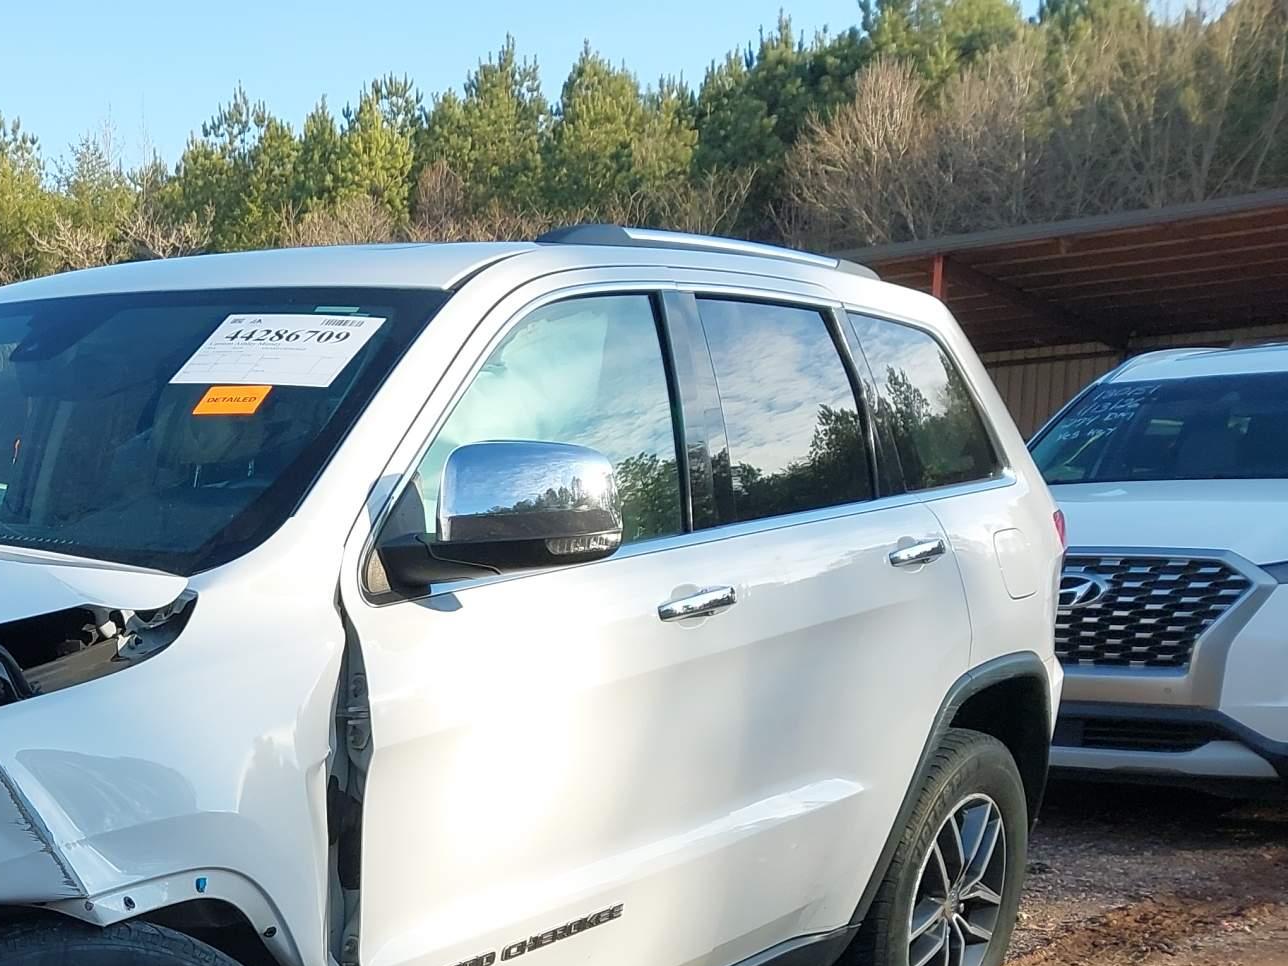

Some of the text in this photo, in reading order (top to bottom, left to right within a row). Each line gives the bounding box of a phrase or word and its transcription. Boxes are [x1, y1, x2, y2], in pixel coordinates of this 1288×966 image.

[225, 328, 351, 344] 44286709
[207, 396, 257, 404] DETAILED
[500, 903, 625, 962] CHEROKEE
